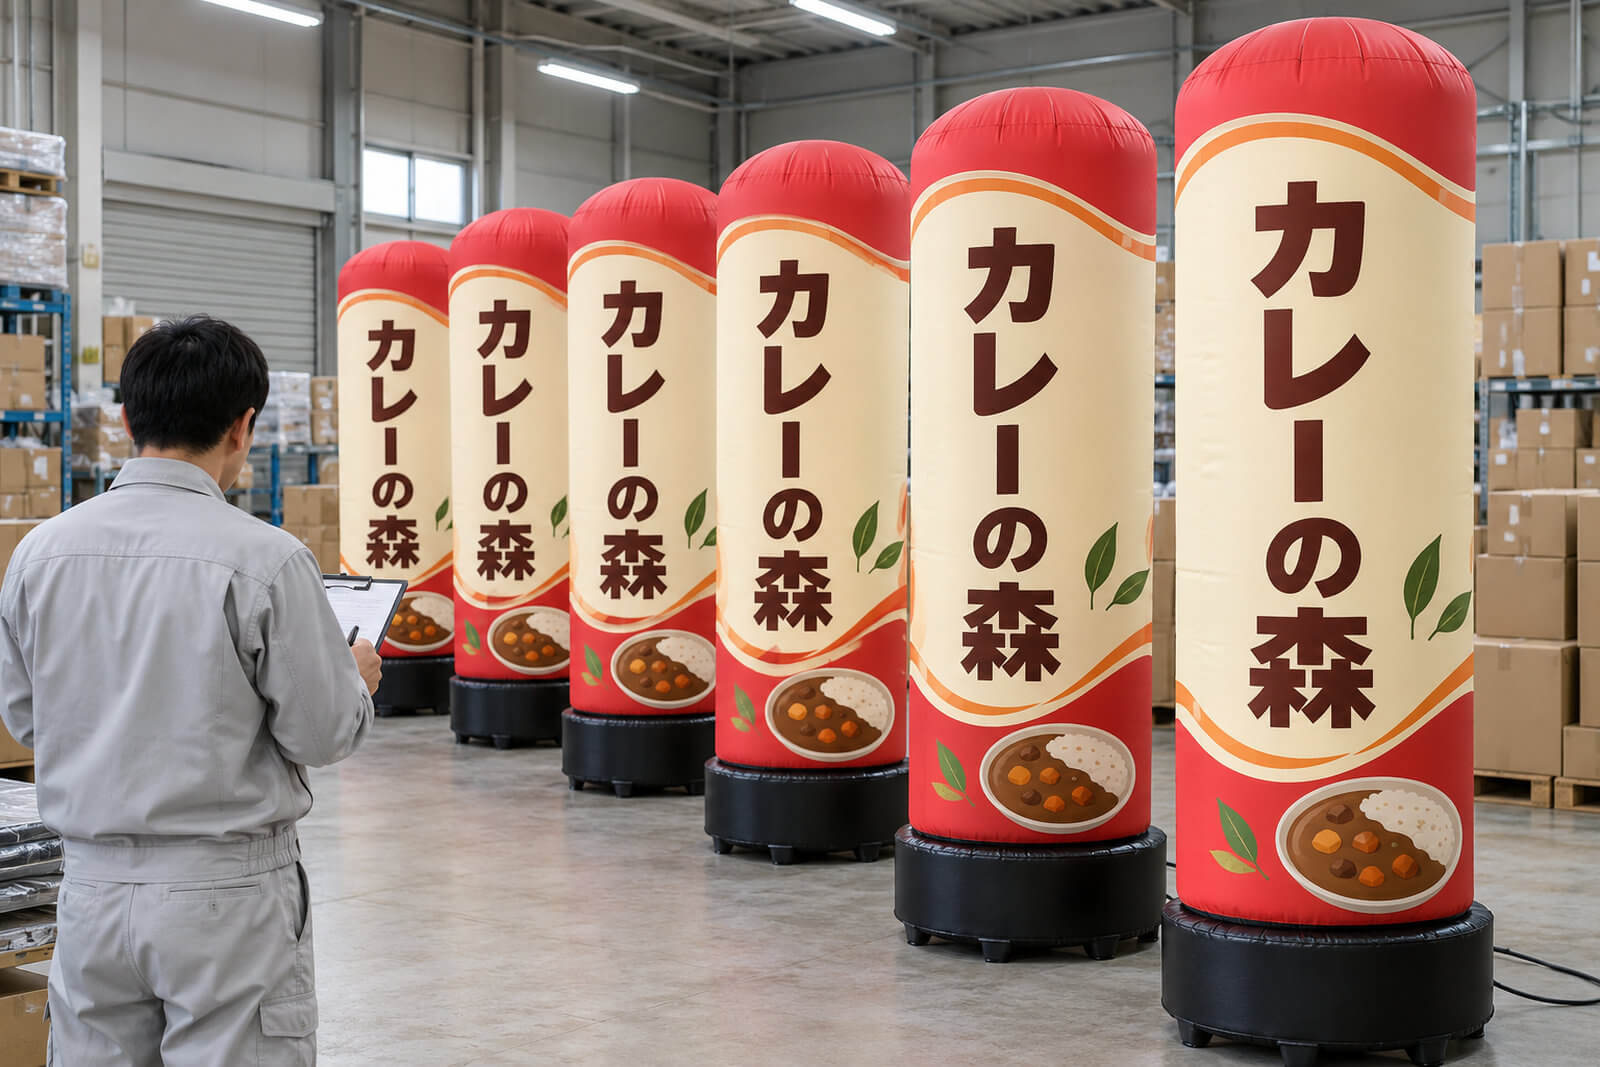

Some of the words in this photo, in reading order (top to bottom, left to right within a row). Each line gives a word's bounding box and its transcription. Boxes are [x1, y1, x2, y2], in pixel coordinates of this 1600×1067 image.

[366, 320, 419, 568] カレーの森
[477, 299, 535, 580] カレーの森
[600, 280, 667, 599] カレーの森
[753, 260, 833, 631] カレーの森
[961, 227, 1061, 681] カレーの森
[1248, 181, 1377, 728] カレーの森
